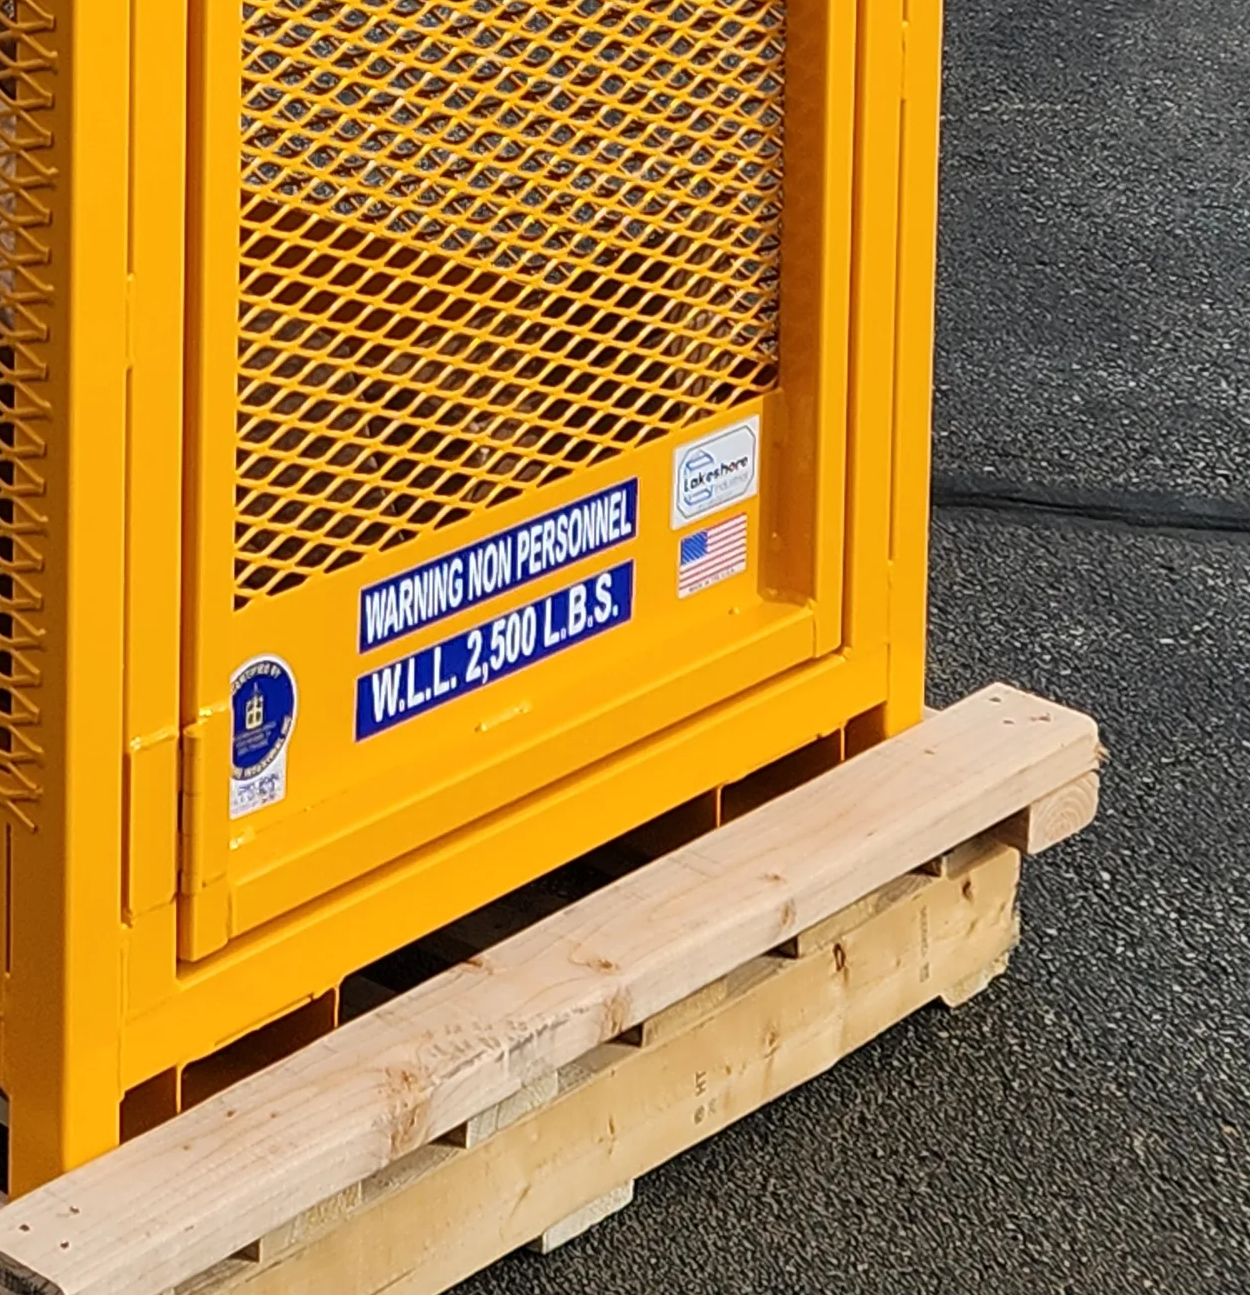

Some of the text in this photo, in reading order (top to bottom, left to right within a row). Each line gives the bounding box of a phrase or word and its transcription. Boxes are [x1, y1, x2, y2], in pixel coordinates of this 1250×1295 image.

[684, 456, 748, 492] Lakeshore
[365, 488, 632, 644] WARNING NON PERSONNEL
[371, 573, 619, 724] W.L.L. 2,500 L.B.S.
